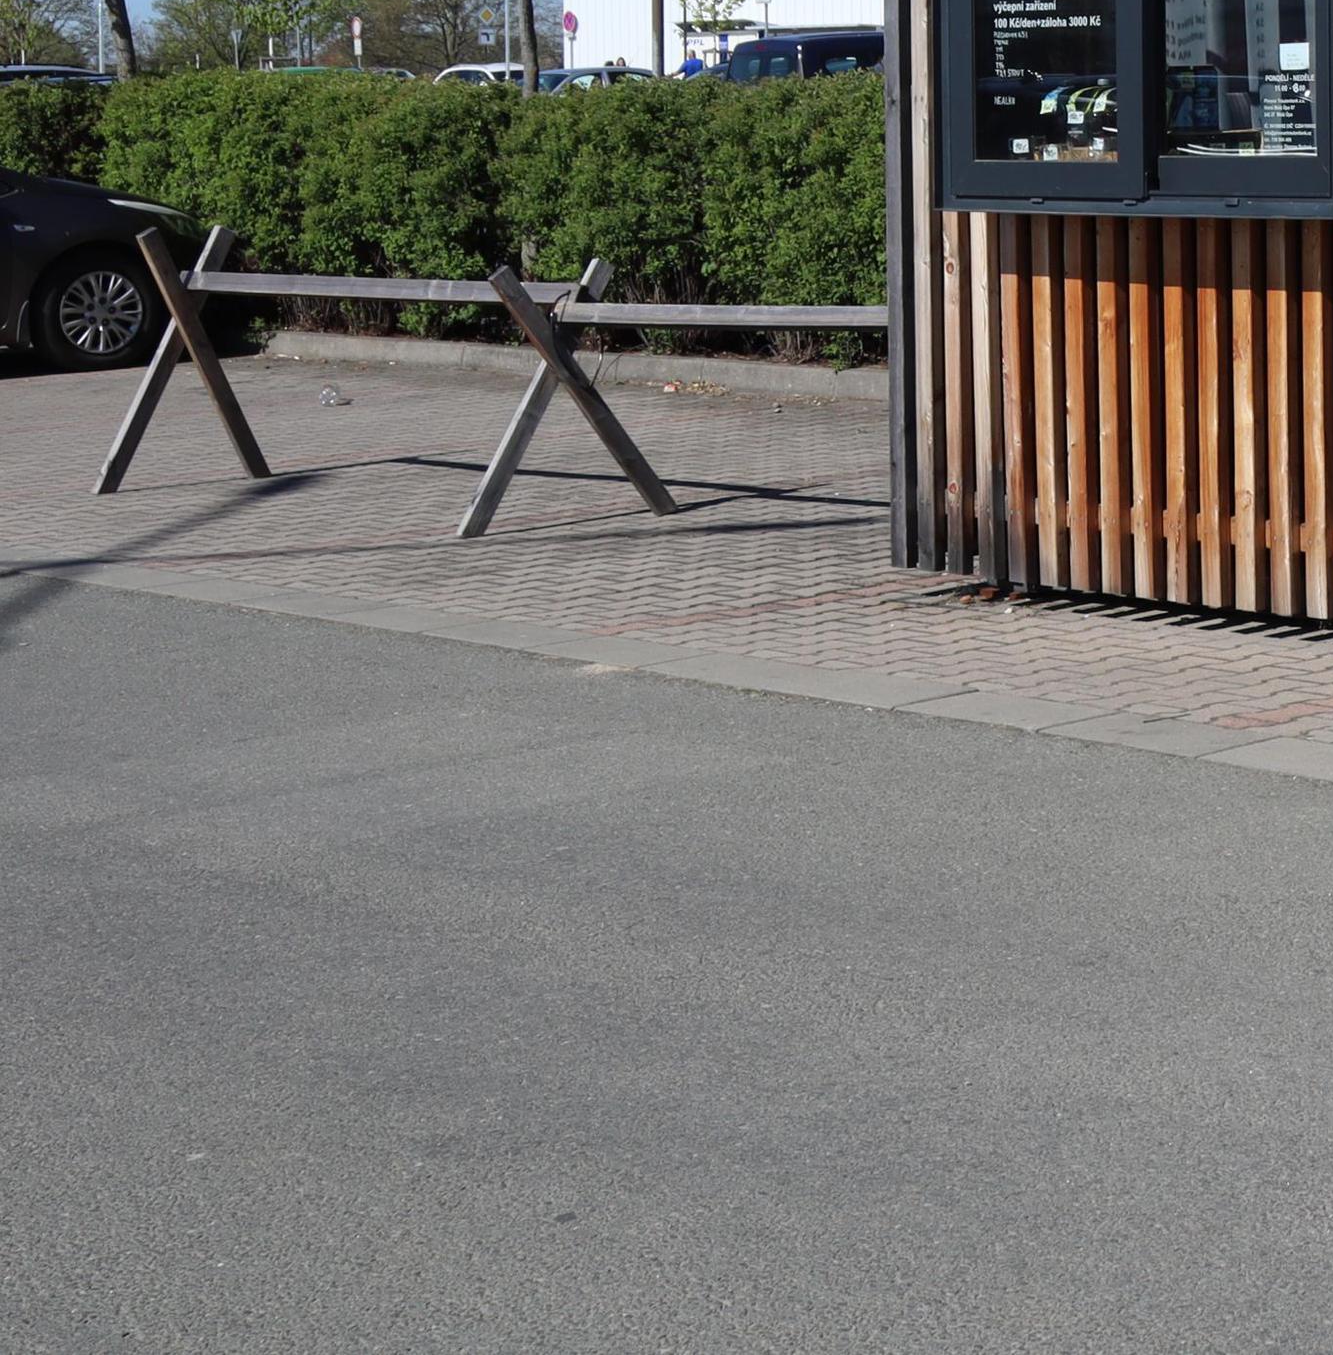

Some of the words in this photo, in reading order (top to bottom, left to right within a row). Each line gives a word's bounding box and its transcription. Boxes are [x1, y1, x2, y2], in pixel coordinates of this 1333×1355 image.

[993, 0, 1024, 14] výčepní
[994, 18, 1007, 28] 100
[1069, 16, 1087, 27] 3000
[1089, 15, 1101, 26] Kč
